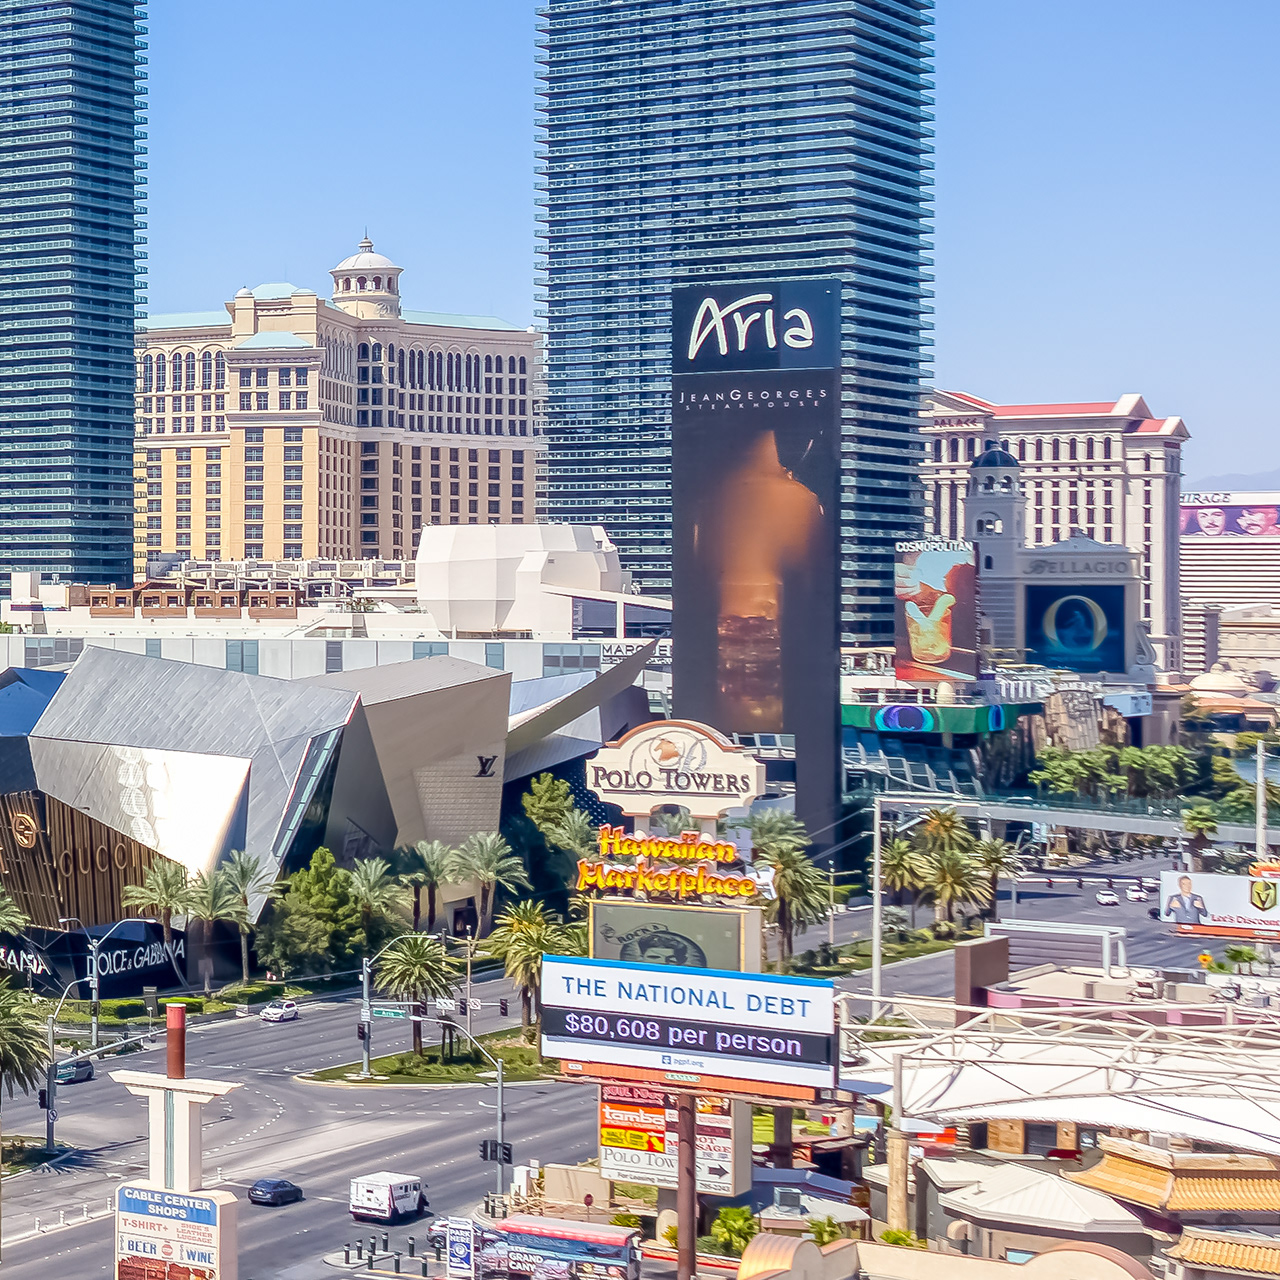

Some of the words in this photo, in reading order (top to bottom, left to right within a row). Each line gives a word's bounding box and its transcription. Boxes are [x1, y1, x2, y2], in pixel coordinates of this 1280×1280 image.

[688, 293, 814, 360] Aria
[685, 400, 820, 411] STEAKHOUSE
[895, 541, 973, 552] COSMOPOLITAN
[1023, 560, 1128, 575] BELLAGIO
[591, 766, 653, 790] POLO
[659, 768, 751, 793] TOWERS
[598, 823, 739, 863] Hawaiian
[576, 858, 758, 899] Marketplace
[562, 976, 606, 998] THE
[618, 981, 736, 1010] NATIONAL
[747, 994, 812, 1018] DEBT
[565, 1013, 660, 1040] $80,608
[668, 1026, 708, 1047] per
[715, 1033, 802, 1057] person
[603, 1147, 640, 1165] POLO
[124, 1188, 162, 1203] CABLE
[164, 1195, 211, 1211] CENTER
[148, 1204, 187, 1219] SHOPS
[176, 1228, 213, 1238] LEATHER
[176, 1234, 212, 1244] LUGGAGE
[128, 1240, 157, 1255] BEER
[186, 1249, 215, 1264] WINE
[508, 1252, 543, 1263] GRAND
[508, 1261, 536, 1272] CANY
